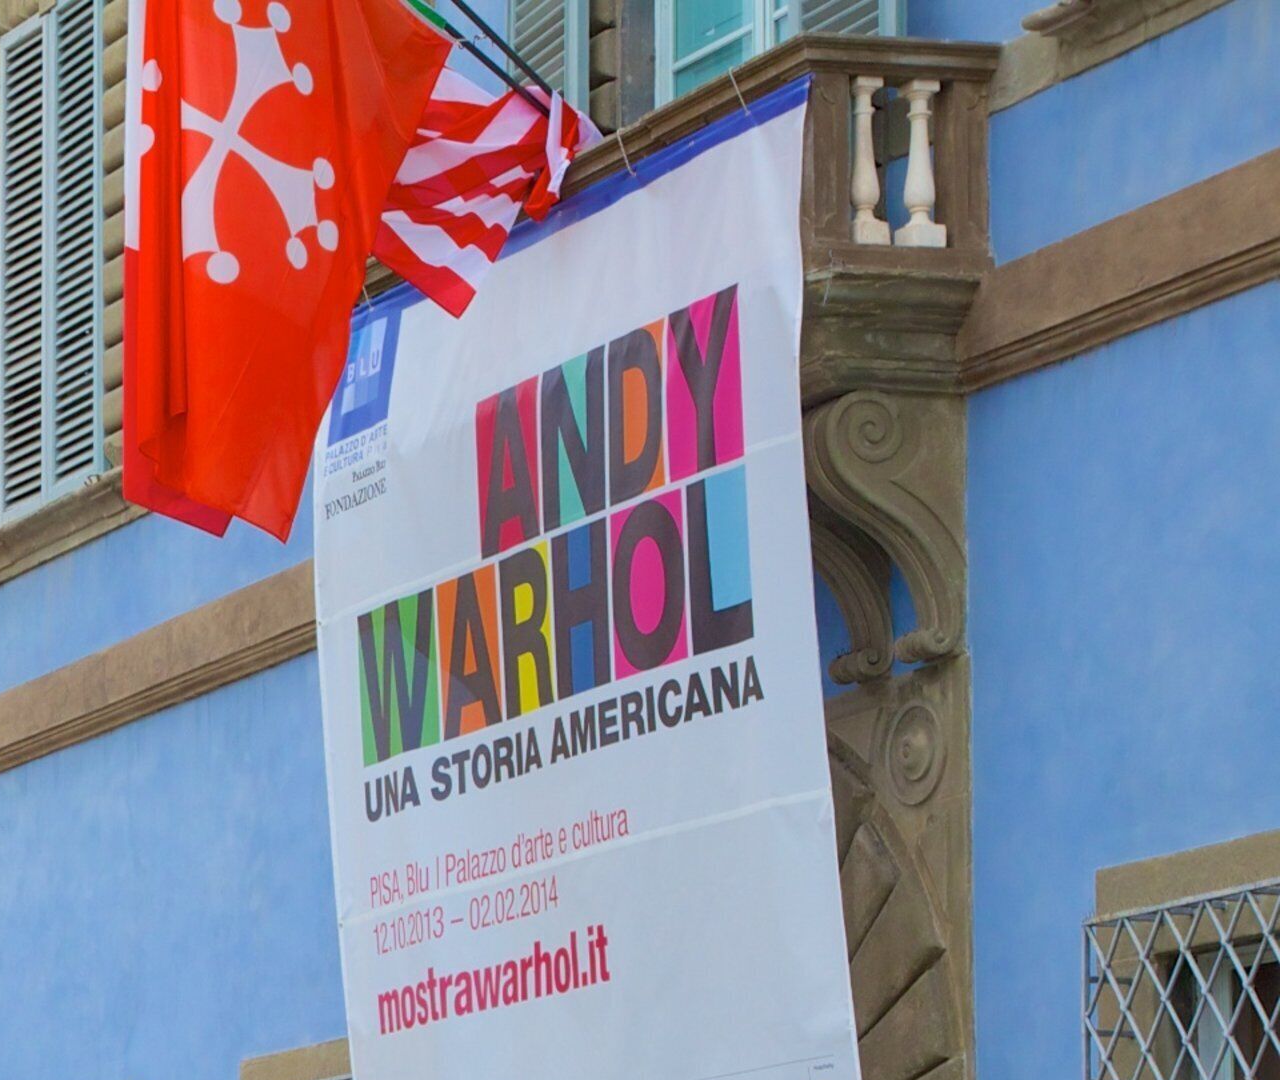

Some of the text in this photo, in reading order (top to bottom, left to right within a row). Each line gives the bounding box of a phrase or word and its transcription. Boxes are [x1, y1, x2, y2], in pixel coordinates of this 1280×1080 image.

[347, 349, 380, 384] BLU
[325, 438, 360, 460] PALAZZO
[481, 283, 741, 560] ANDY
[324, 477, 387, 520] FONDAZIONE
[357, 480, 754, 765] WARHOL
[363, 654, 765, 823] UNA STORIA AMERICANA
[369, 869, 404, 909] PISA,
[406, 860, 430, 897] Blu
[445, 846, 507, 887] Palazzo
[511, 828, 554, 869] d'arte
[558, 833, 568, 855] e
[572, 808, 630, 851] cultura
[372, 905, 445, 956] 12.10.2013
[469, 875, 559, 931] 02.02.2014
[377, 923, 611, 1035] mostrawarhol.it
